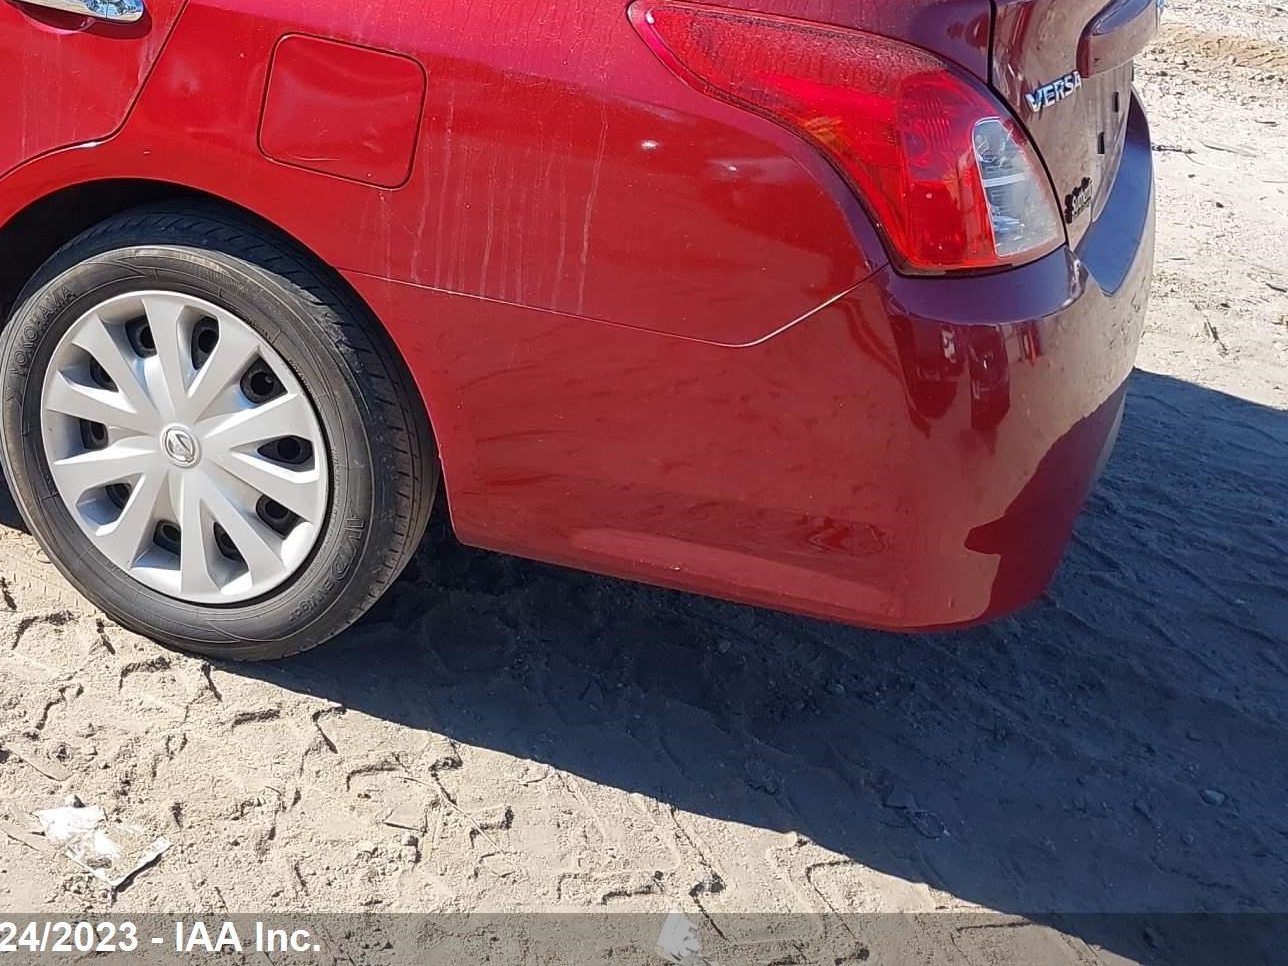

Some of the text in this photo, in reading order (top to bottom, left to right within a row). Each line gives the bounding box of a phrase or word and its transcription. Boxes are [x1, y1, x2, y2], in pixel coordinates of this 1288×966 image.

[1024, 70, 1082, 112] VERSA
[9, 284, 78, 377] YOKOHAMA
[331, 514, 365, 580] AVID
